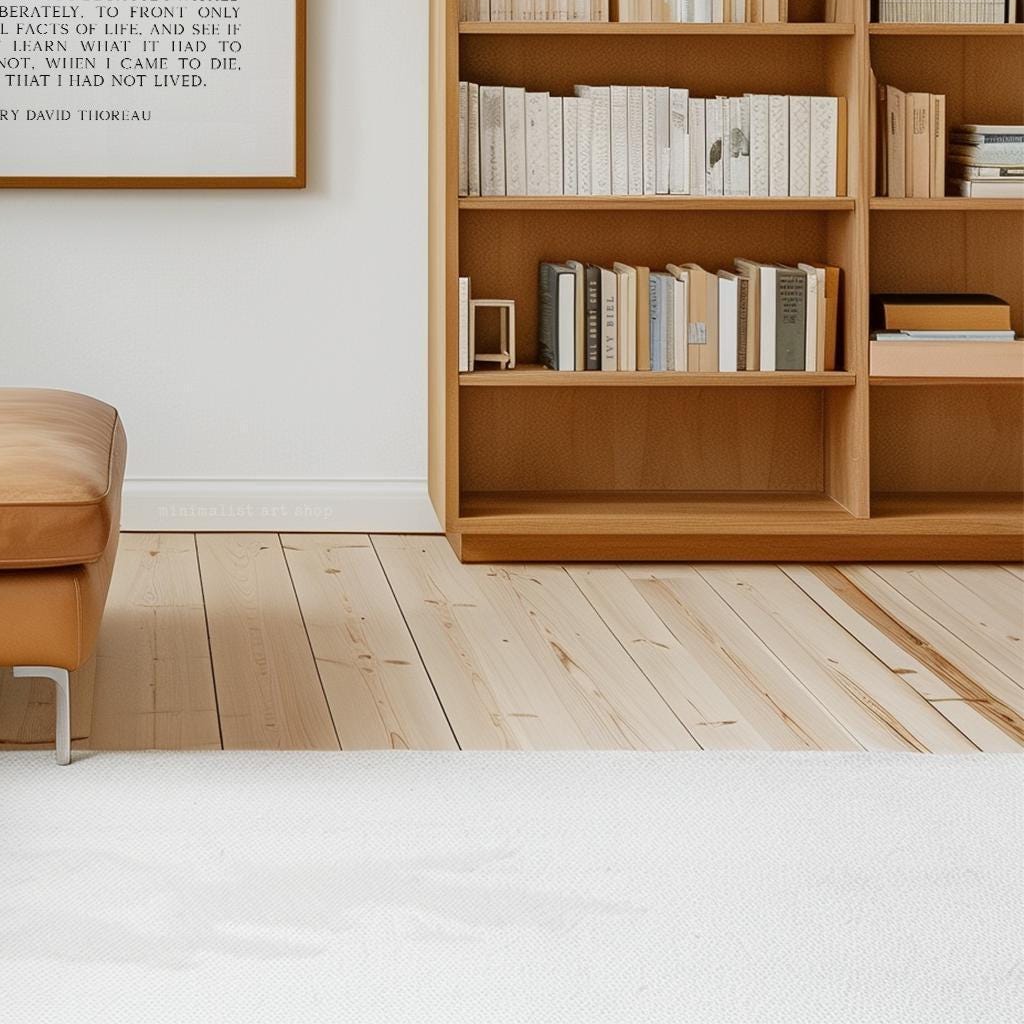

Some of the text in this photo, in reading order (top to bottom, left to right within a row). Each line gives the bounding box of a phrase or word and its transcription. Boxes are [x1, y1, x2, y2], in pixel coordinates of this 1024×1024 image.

[95, 5, 119, 18] TO
[129, 5, 187, 18] FRONT
[197, 5, 240, 18] ONLY
[16, 23, 70, 36] FACTS
[75, 23, 98, 36] OF
[149, 23, 185, 36] AND
[192, 23, 220, 36] SEE
[227, 23, 242, 36] IF
[13, 40, 67, 53] LEARN
[79, 40, 131, 53] WHAT
[143, 40, 160, 53] IT
[171, 40, 207, 53] HAD
[218, 40, 242, 53] TO
[44, 57, 96, 70] WHEN
[106, 57, 110, 70] I
[120, 57, 168, 70] CAME
[177, 57, 201, 70] TO
[4, 74, 51, 87] THAT
[57, 74, 62, 87] I
[68, 74, 105, 87] HAD
[111, 74, 148, 87] NOT
[154, 74, 207, 87] LIVED.
[26, 109, 72, 121] DAVID
[77, 109, 152, 121] THOREAU
[589, 281, 598, 361] ALL ABOUT CATS
[606, 296, 614, 359] IVY BIEL
